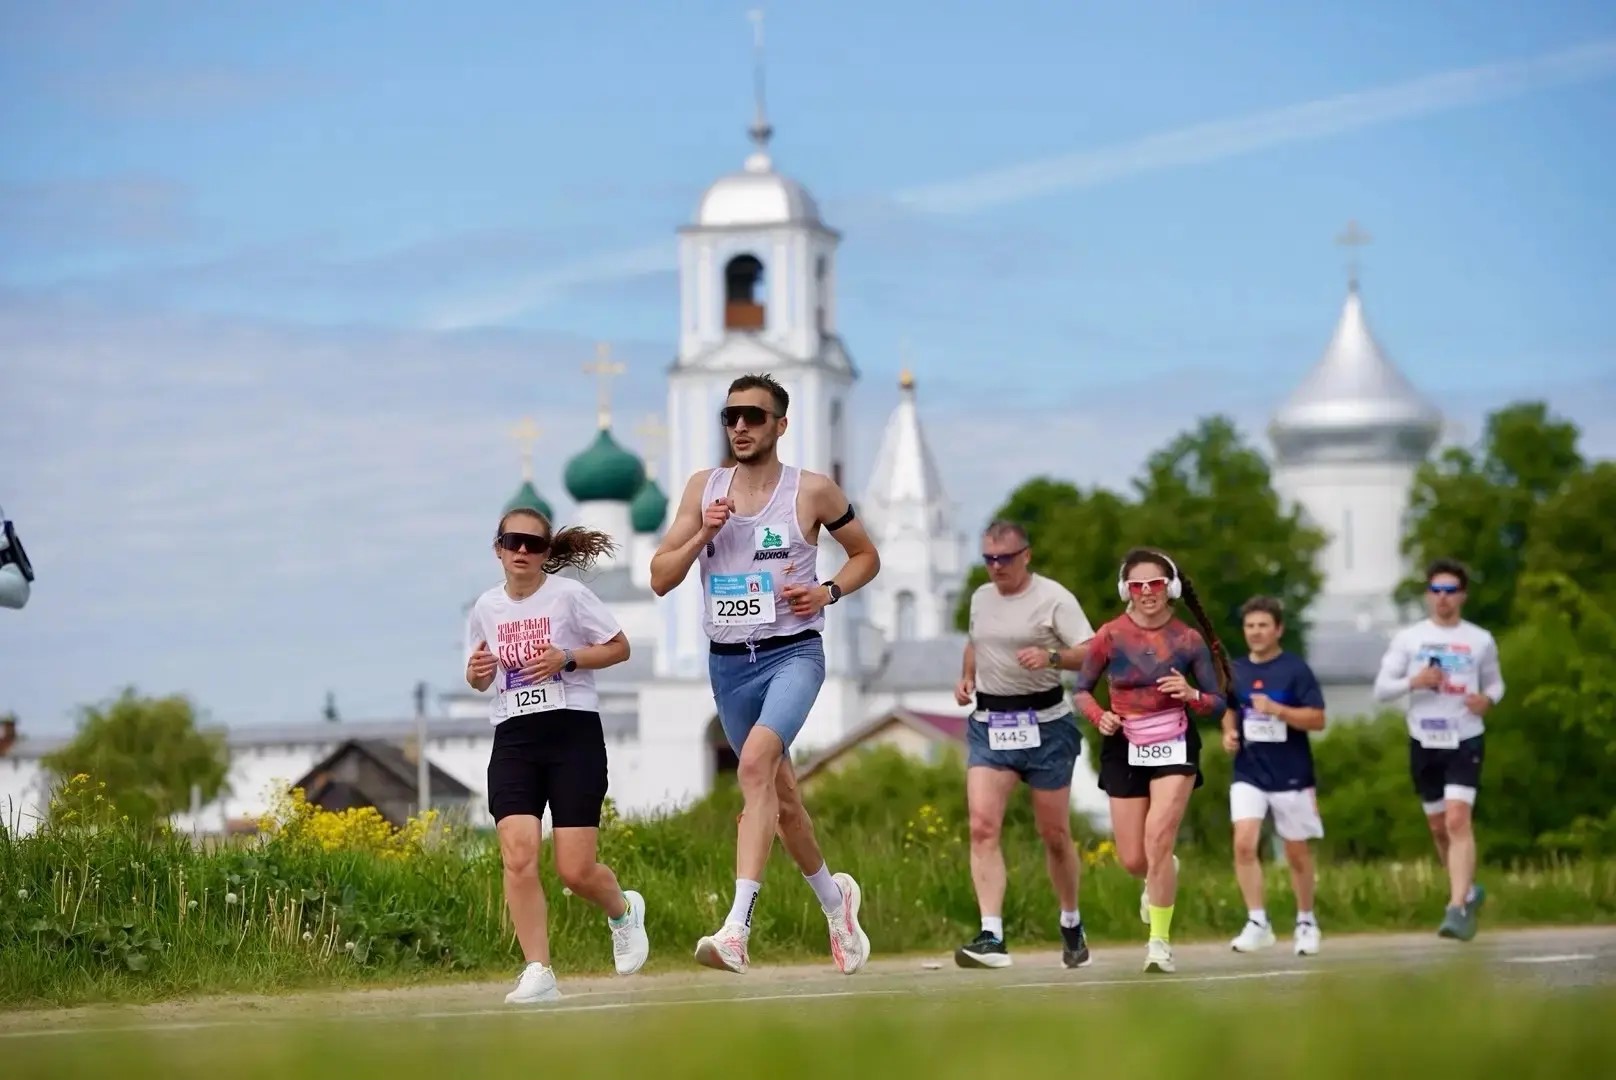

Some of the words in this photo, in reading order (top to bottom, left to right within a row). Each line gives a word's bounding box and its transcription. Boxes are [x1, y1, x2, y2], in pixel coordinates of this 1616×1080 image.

[753, 551, 790, 562] ADIXION
[716, 598, 761, 616] 2295
[499, 639, 552, 670] БЕГАЛ
[515, 688, 548, 707] 1251
[994, 731, 1028, 744] 1445
[1136, 745, 1172, 758] 1589
